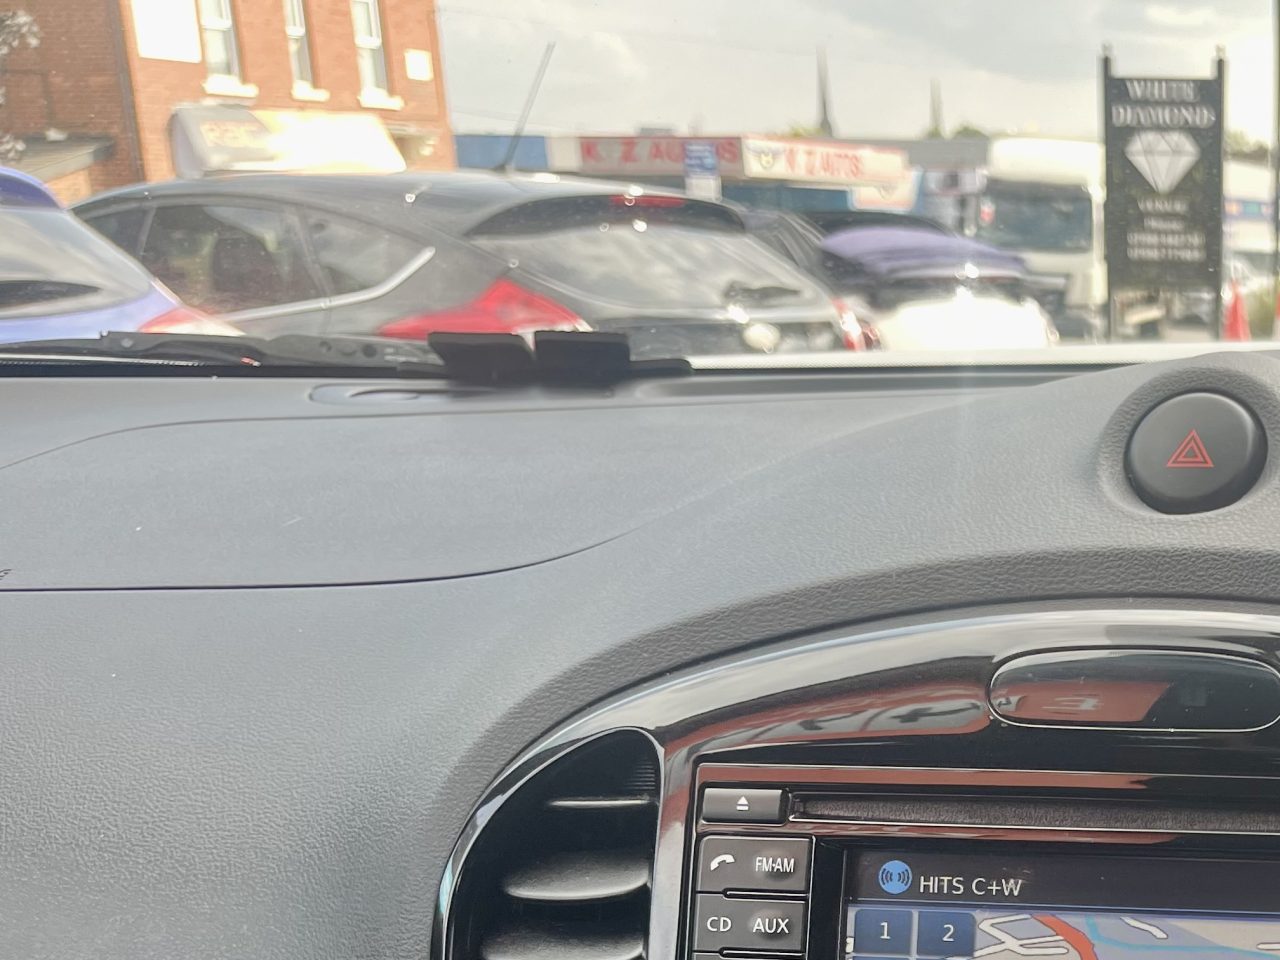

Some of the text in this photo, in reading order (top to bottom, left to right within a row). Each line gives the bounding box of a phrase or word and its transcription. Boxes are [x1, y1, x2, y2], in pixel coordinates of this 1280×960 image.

[1124, 79, 1198, 102] WHITE
[920, 876, 1022, 897] HITS C+W
[706, 917, 732, 932] CD
[753, 918, 789, 934] AUX
[880, 923, 891, 939] 1
[942, 925, 955, 941] 2
